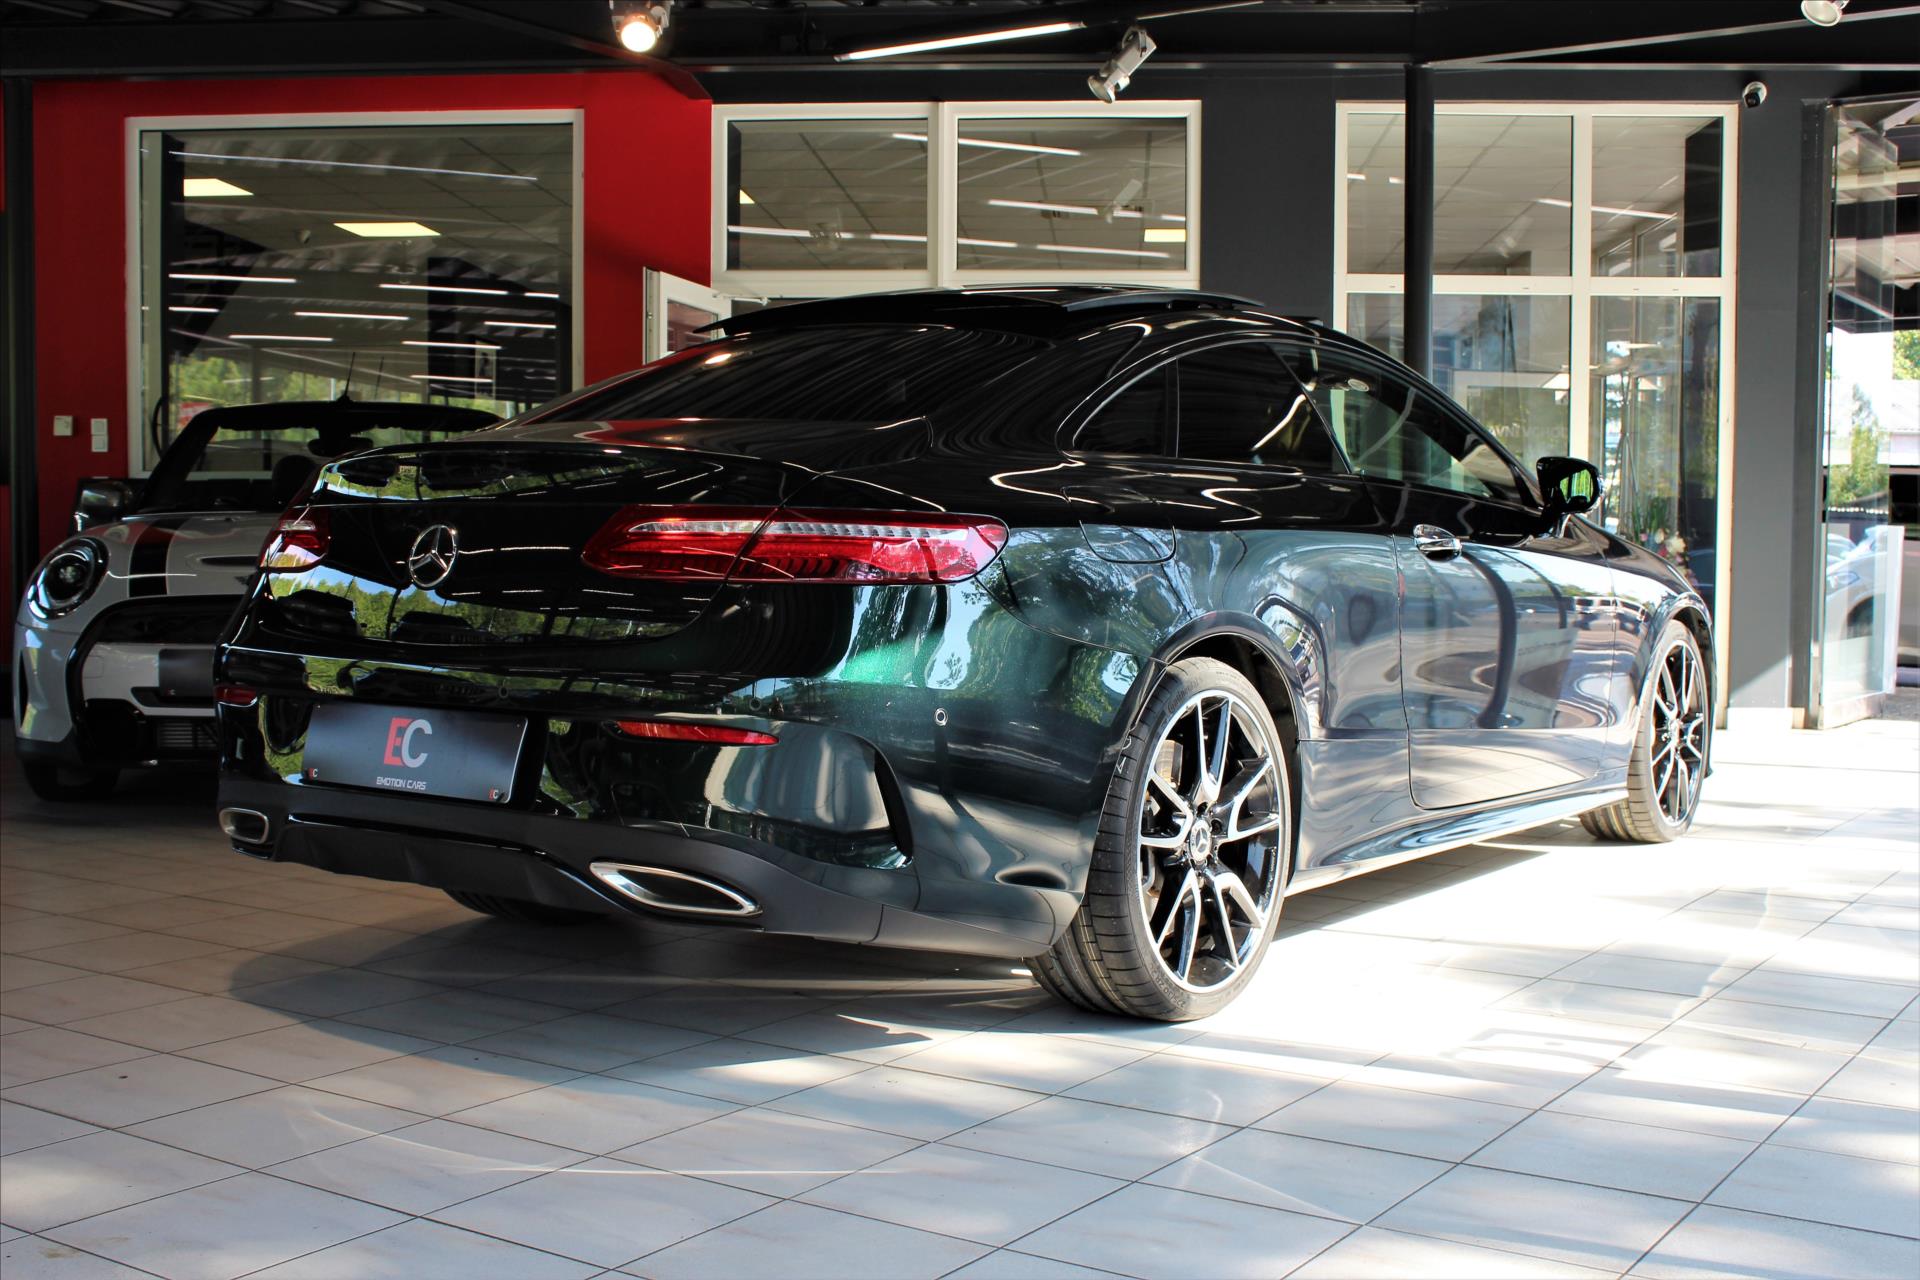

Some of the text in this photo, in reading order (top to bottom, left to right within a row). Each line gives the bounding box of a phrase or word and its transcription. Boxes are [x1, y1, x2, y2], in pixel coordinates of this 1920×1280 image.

[384, 717, 432, 768] EC
[376, 776, 427, 790] EMOTION CARS
